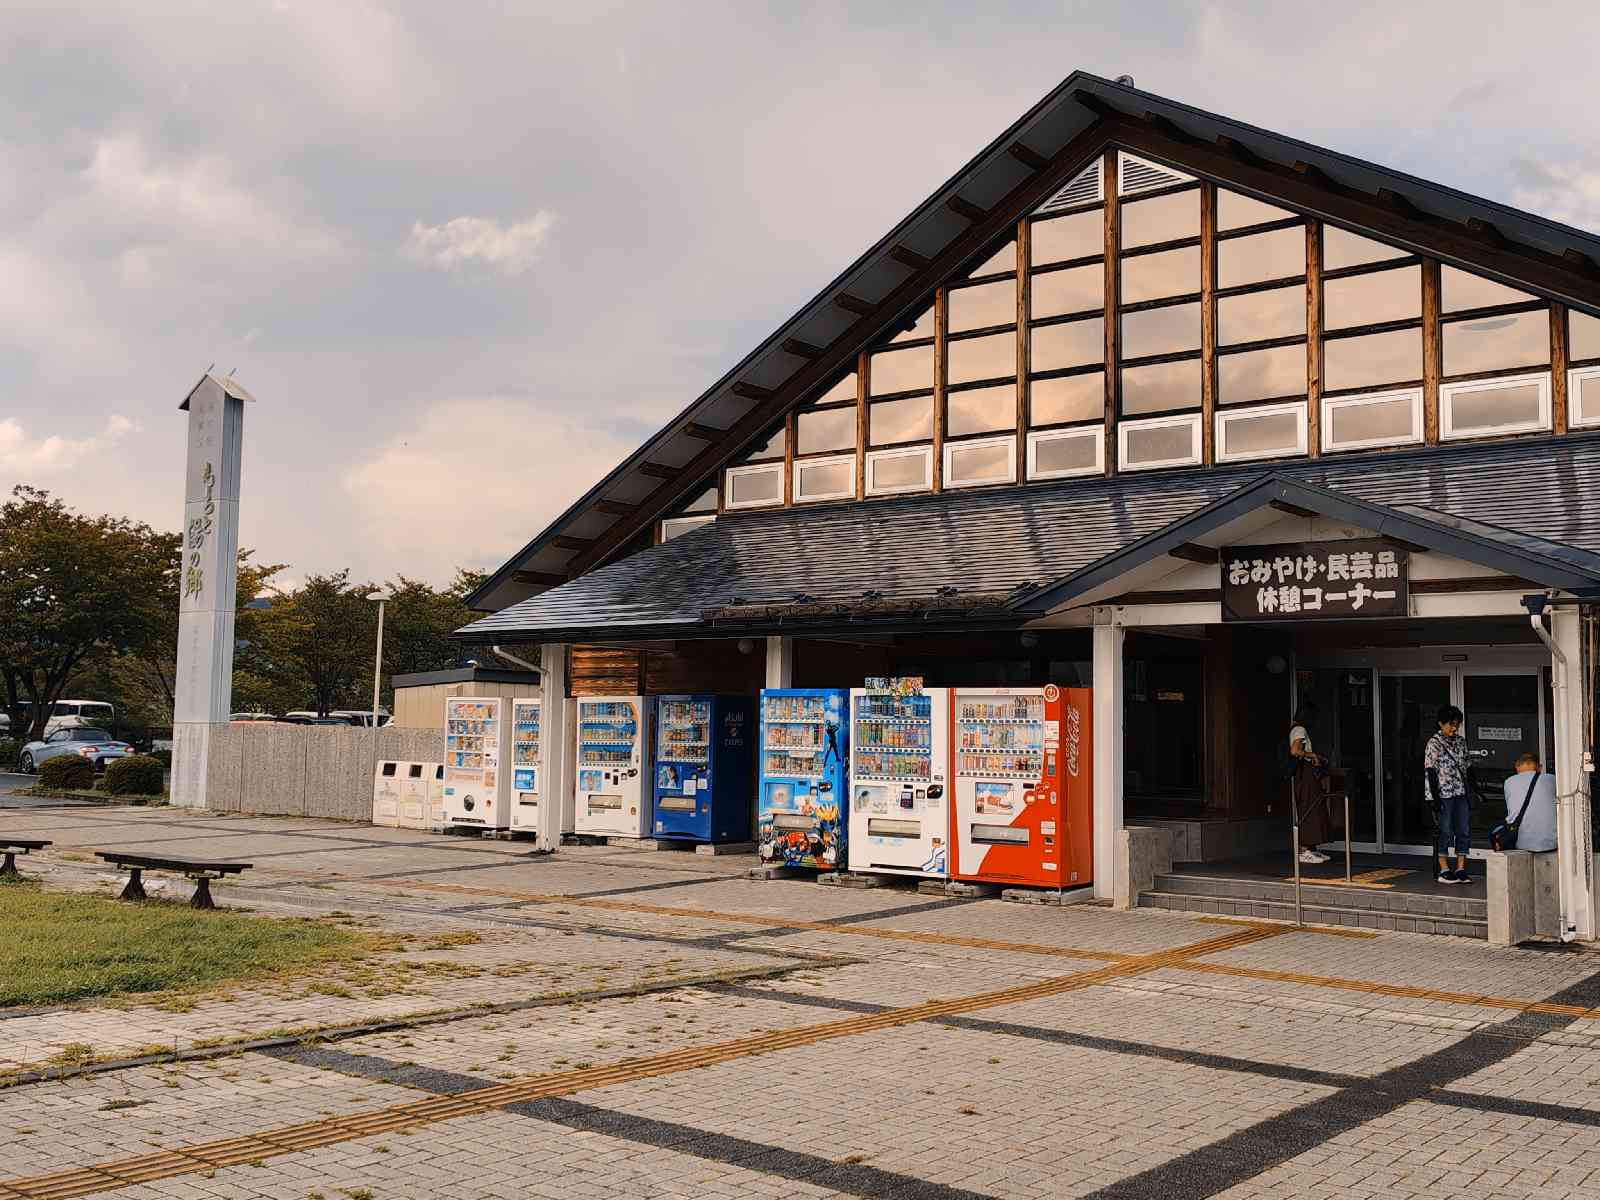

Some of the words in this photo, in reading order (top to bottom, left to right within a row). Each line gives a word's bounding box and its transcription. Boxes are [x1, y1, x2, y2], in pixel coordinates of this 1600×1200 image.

[1256, 582, 1396, 613] 休憩コーナー
